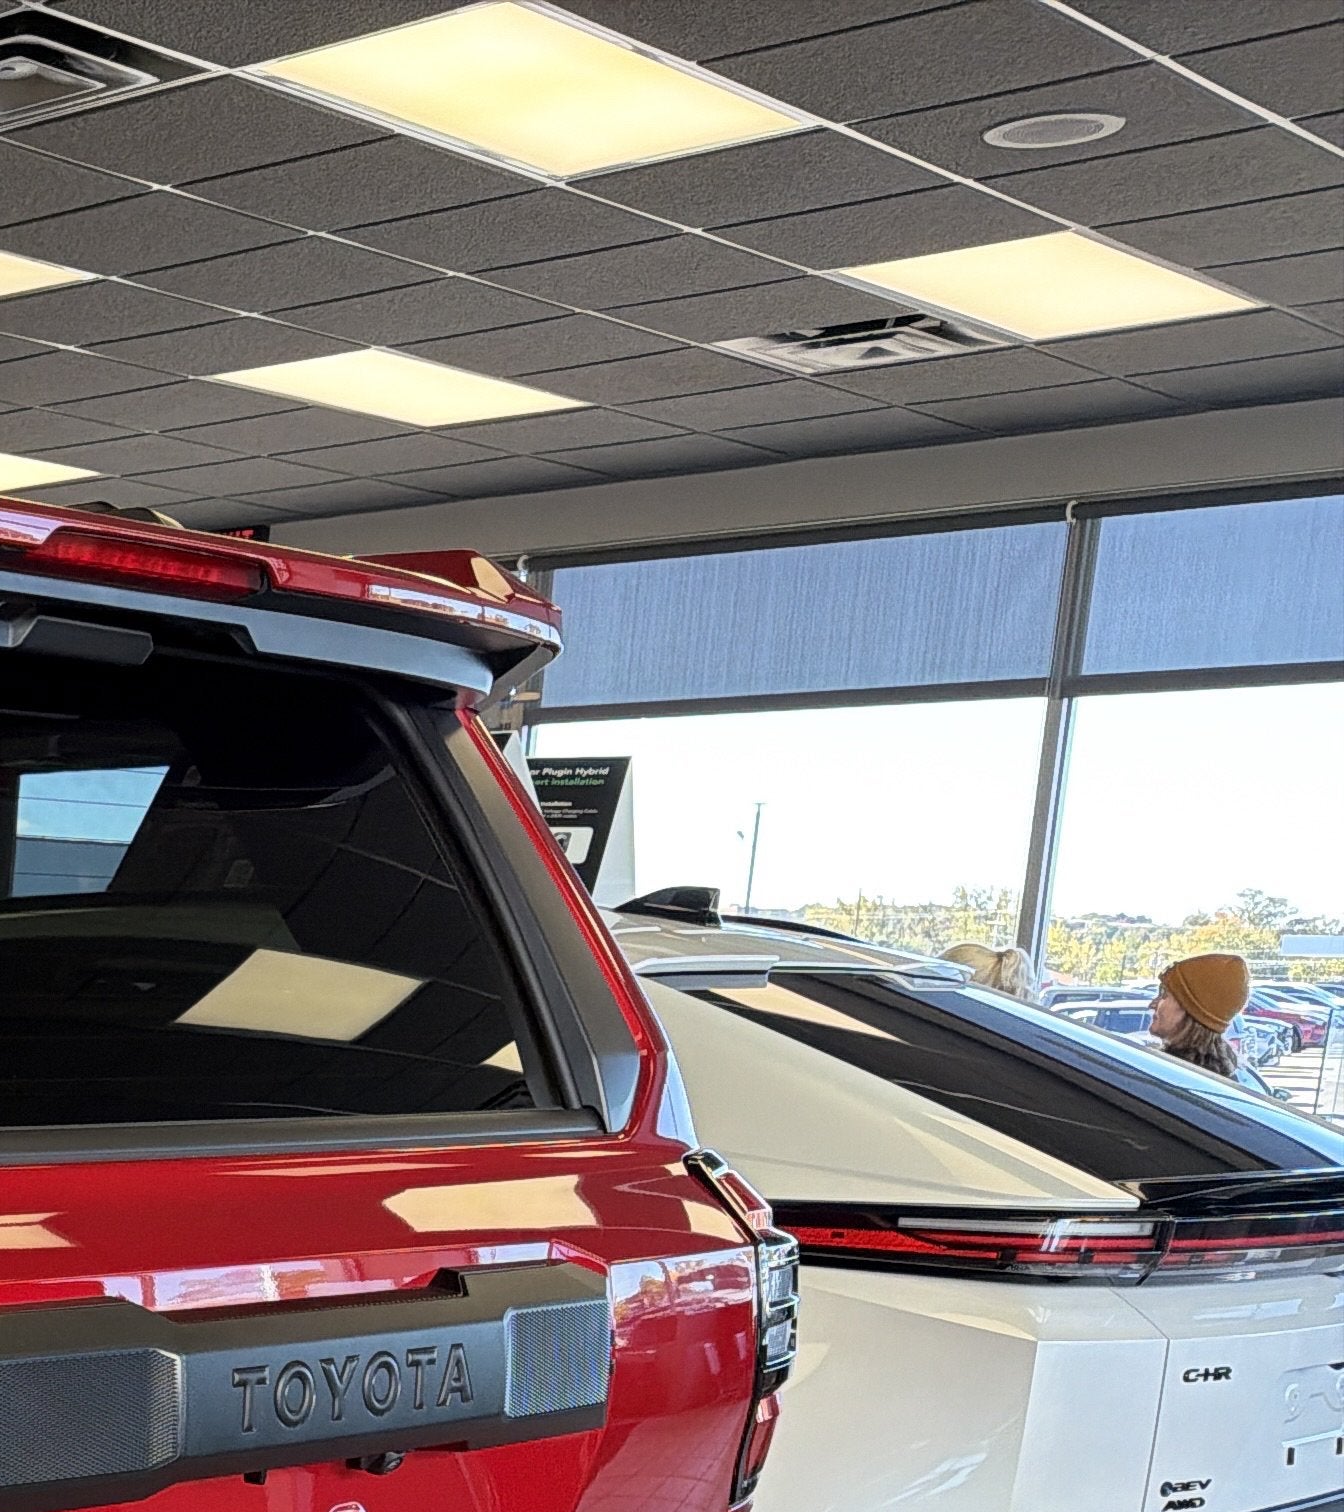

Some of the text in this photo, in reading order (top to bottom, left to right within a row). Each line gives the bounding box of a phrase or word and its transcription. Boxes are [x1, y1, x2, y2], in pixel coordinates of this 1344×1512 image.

[541, 767, 572, 777] Plugin
[575, 767, 610, 777] Hybrid
[551, 777, 605, 786] installation
[1182, 1365, 1233, 1384] C-HR
[231, 1342, 474, 1433] TOYOTA
[1172, 1478, 1212, 1493] BEV
[1161, 1497, 1206, 1512] AWD
